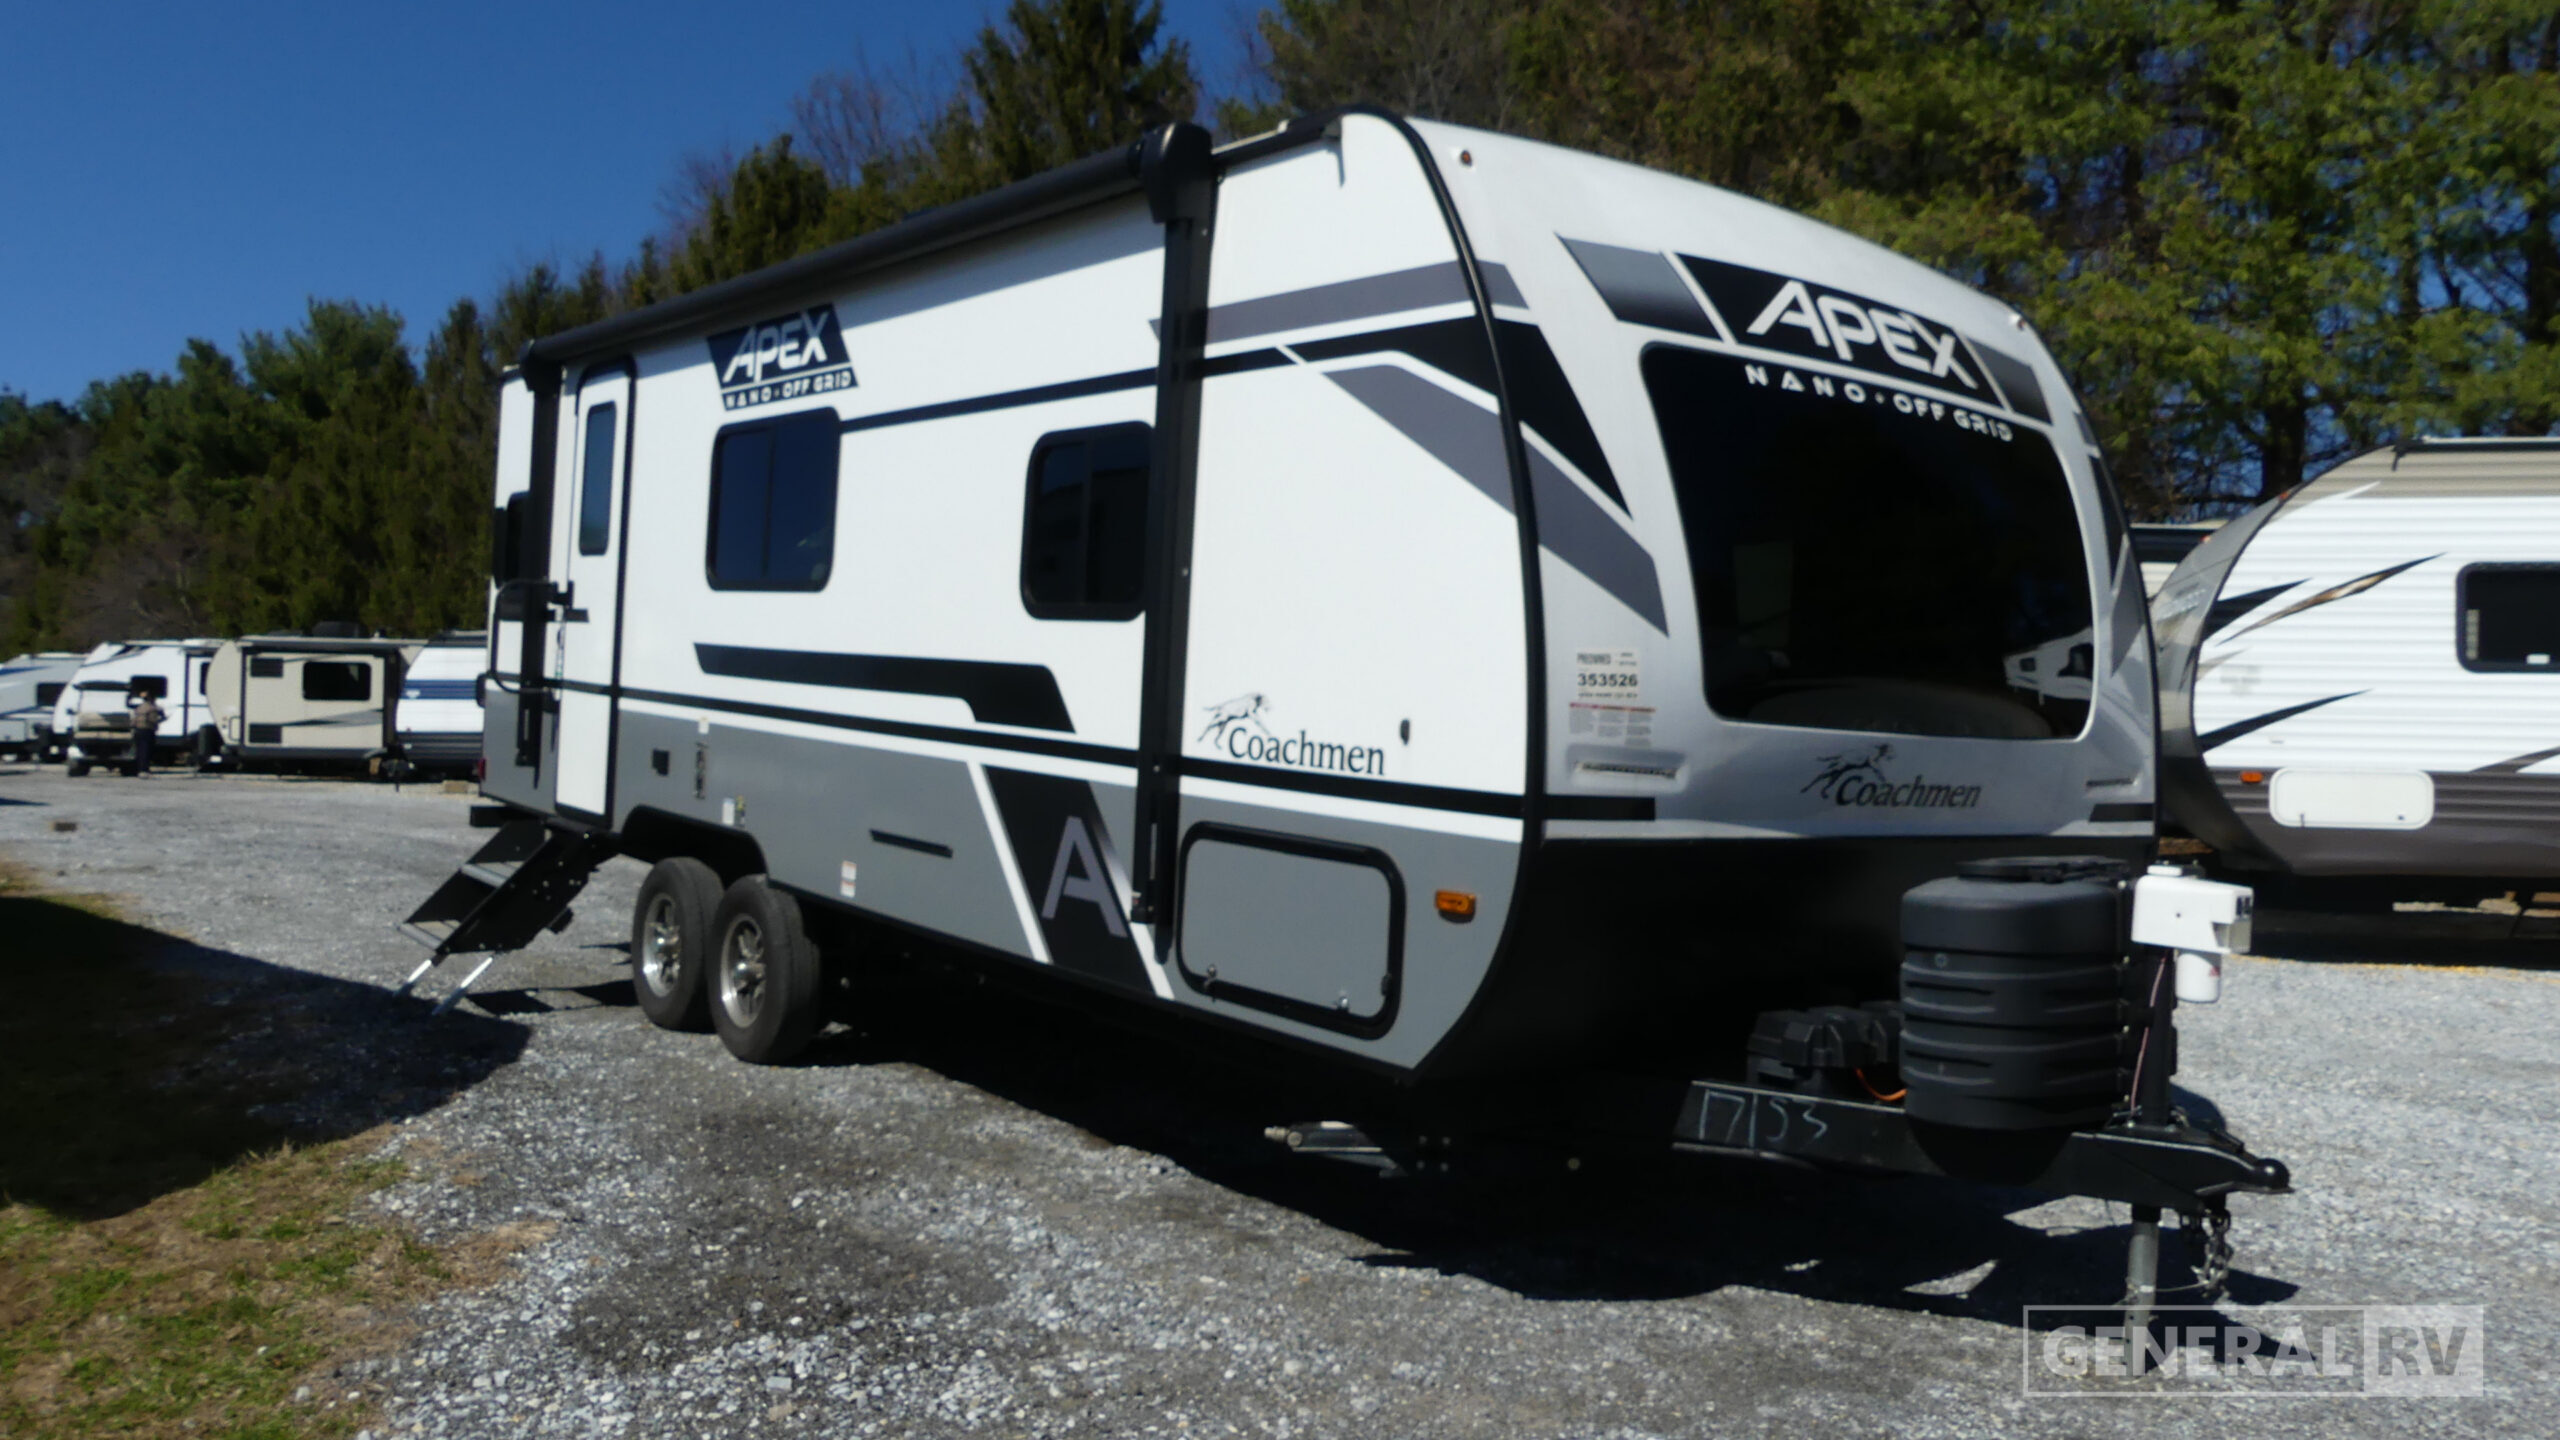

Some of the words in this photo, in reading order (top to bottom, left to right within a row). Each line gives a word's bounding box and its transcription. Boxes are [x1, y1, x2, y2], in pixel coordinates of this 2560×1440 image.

[722, 311, 830, 383] APEX
[1746, 279, 1979, 390] APEX
[725, 386, 772, 408] NANO
[782, 378, 811, 398] OFF
[813, 370, 851, 392] GRID
[1745, 364, 1867, 404] NANO
[1893, 393, 1945, 422] OFF
[1953, 408, 2013, 442] GRID
[1577, 673, 1638, 687] 353526
[1229, 727, 1385, 776] Coachmen
[1835, 775, 1982, 808] Coachmen
[1042, 816, 1128, 938] A
